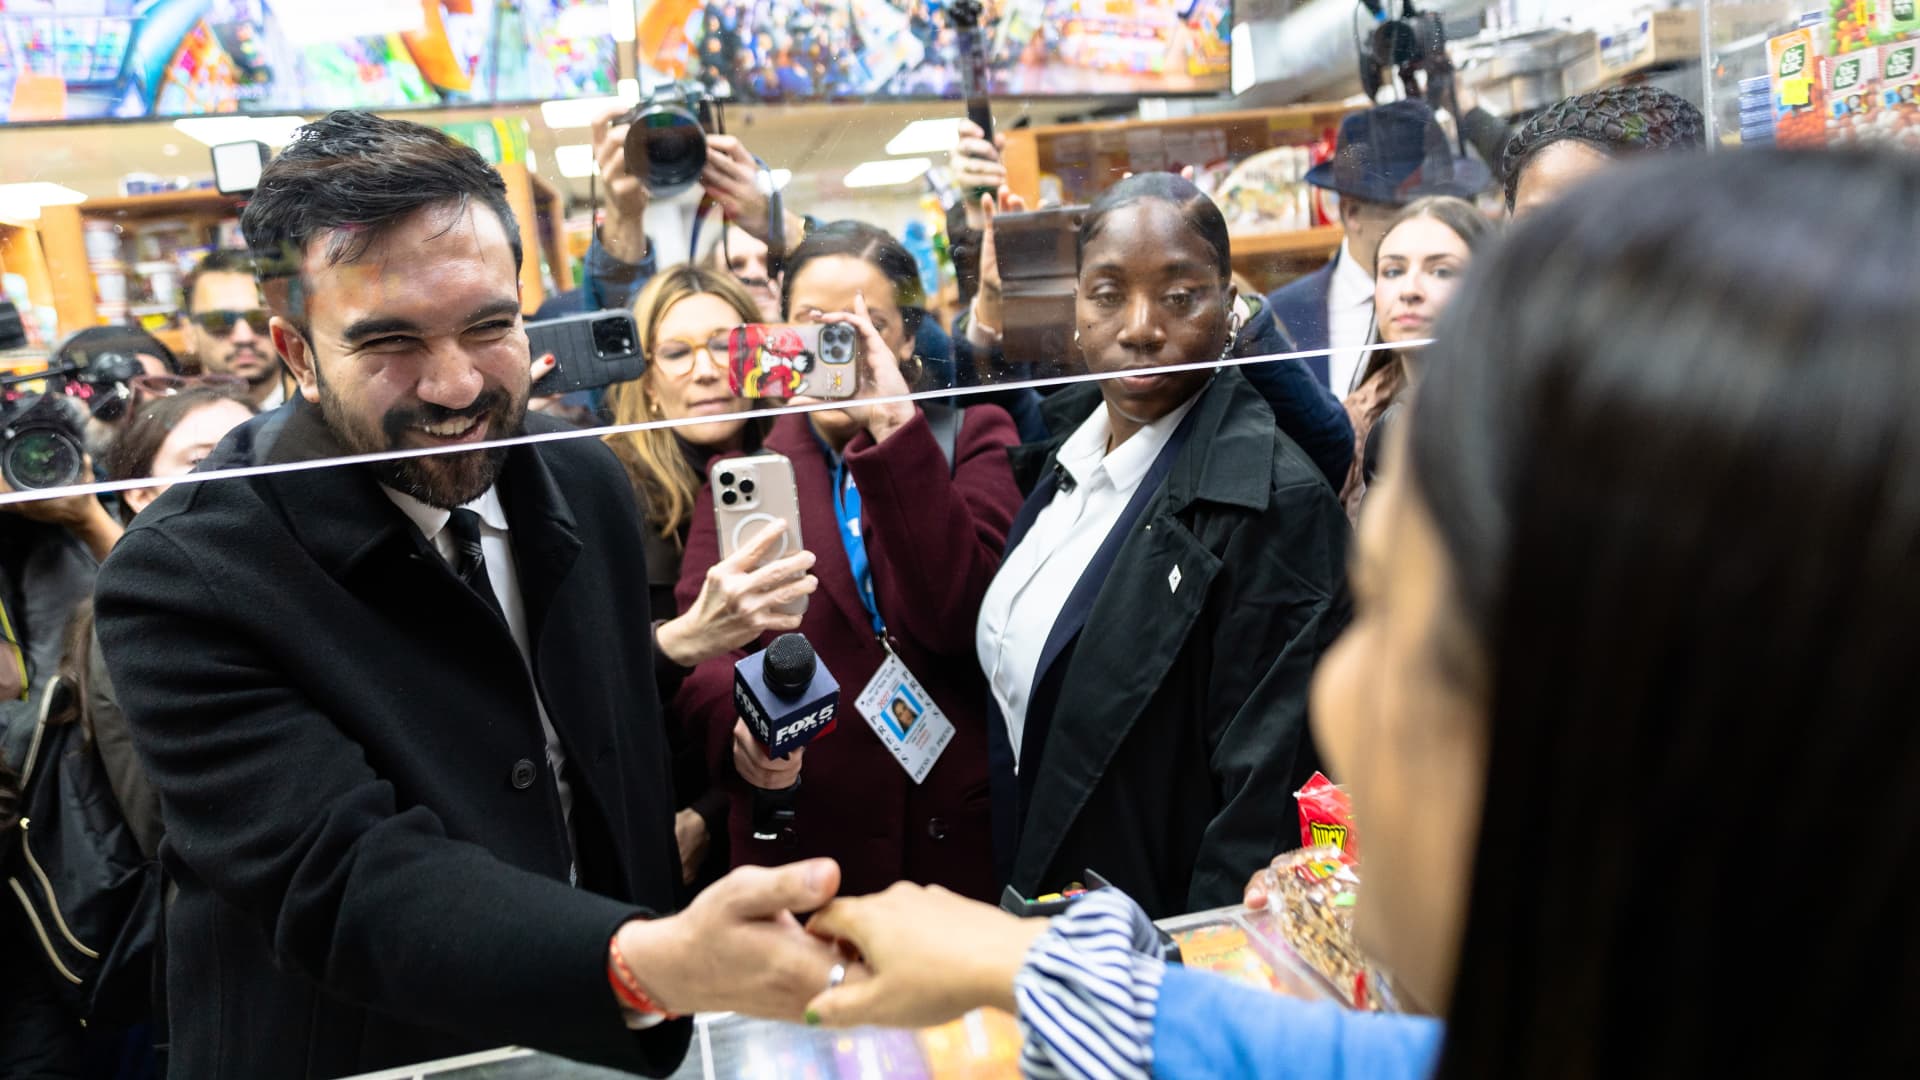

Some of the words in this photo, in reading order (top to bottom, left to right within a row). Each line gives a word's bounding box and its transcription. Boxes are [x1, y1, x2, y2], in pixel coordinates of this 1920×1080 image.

[902, 670, 940, 720] PRESS
[776, 711, 818, 742] FOX
[819, 703, 834, 720] 5
[880, 714, 909, 765] PRESS
